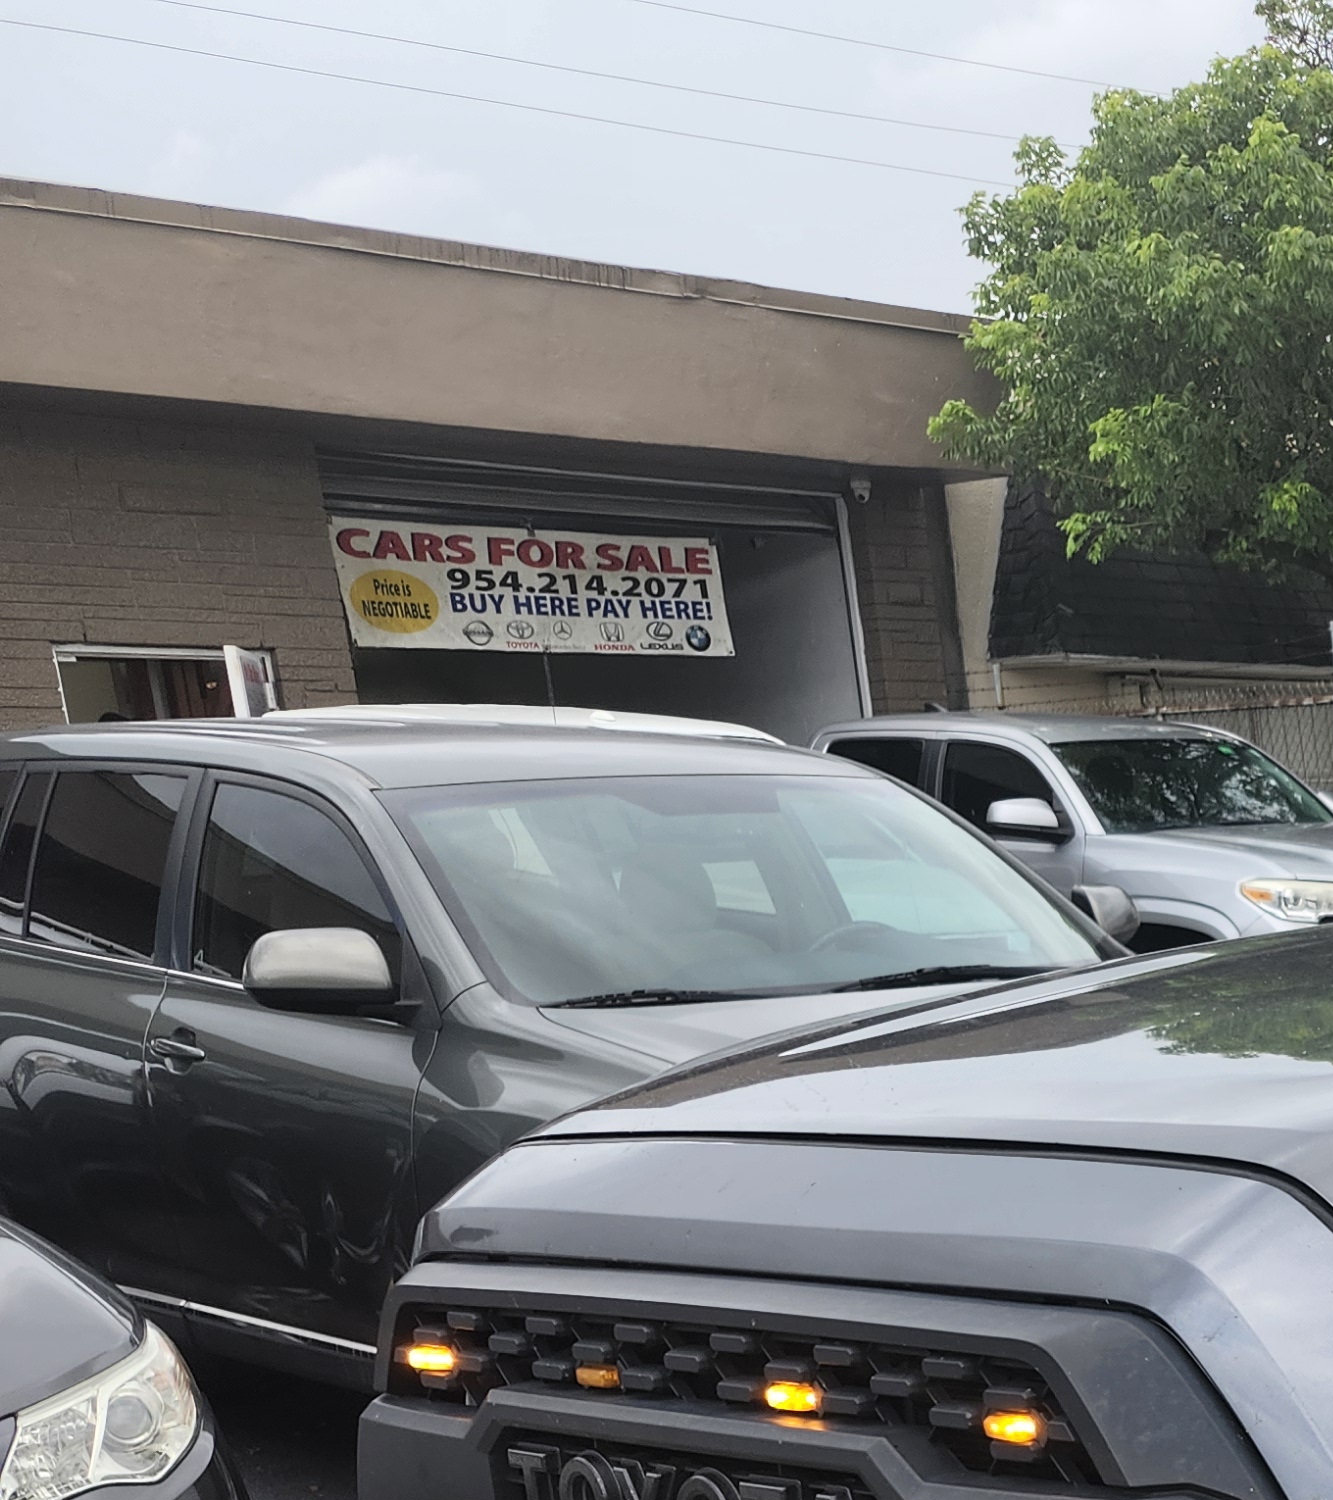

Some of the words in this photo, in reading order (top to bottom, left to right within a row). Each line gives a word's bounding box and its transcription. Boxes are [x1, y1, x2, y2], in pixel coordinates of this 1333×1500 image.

[336, 528, 476, 565] CARS
[487, 536, 587, 570] FOR
[595, 543, 713, 575] SALE
[373, 578, 401, 597] Price
[402, 582, 412, 597] is
[447, 568, 709, 600] 954.214.2071
[362, 599, 432, 620] NEGOTIABLE
[449, 592, 505, 615] BUY
[513, 595, 581, 617] HERE
[586, 597, 632, 619] PAY
[639, 599, 713, 621] HERE!
[506, 641, 539, 650] TOYOTA
[594, 643, 636, 652] HONDA
[640, 642, 684, 651] LEXUS
